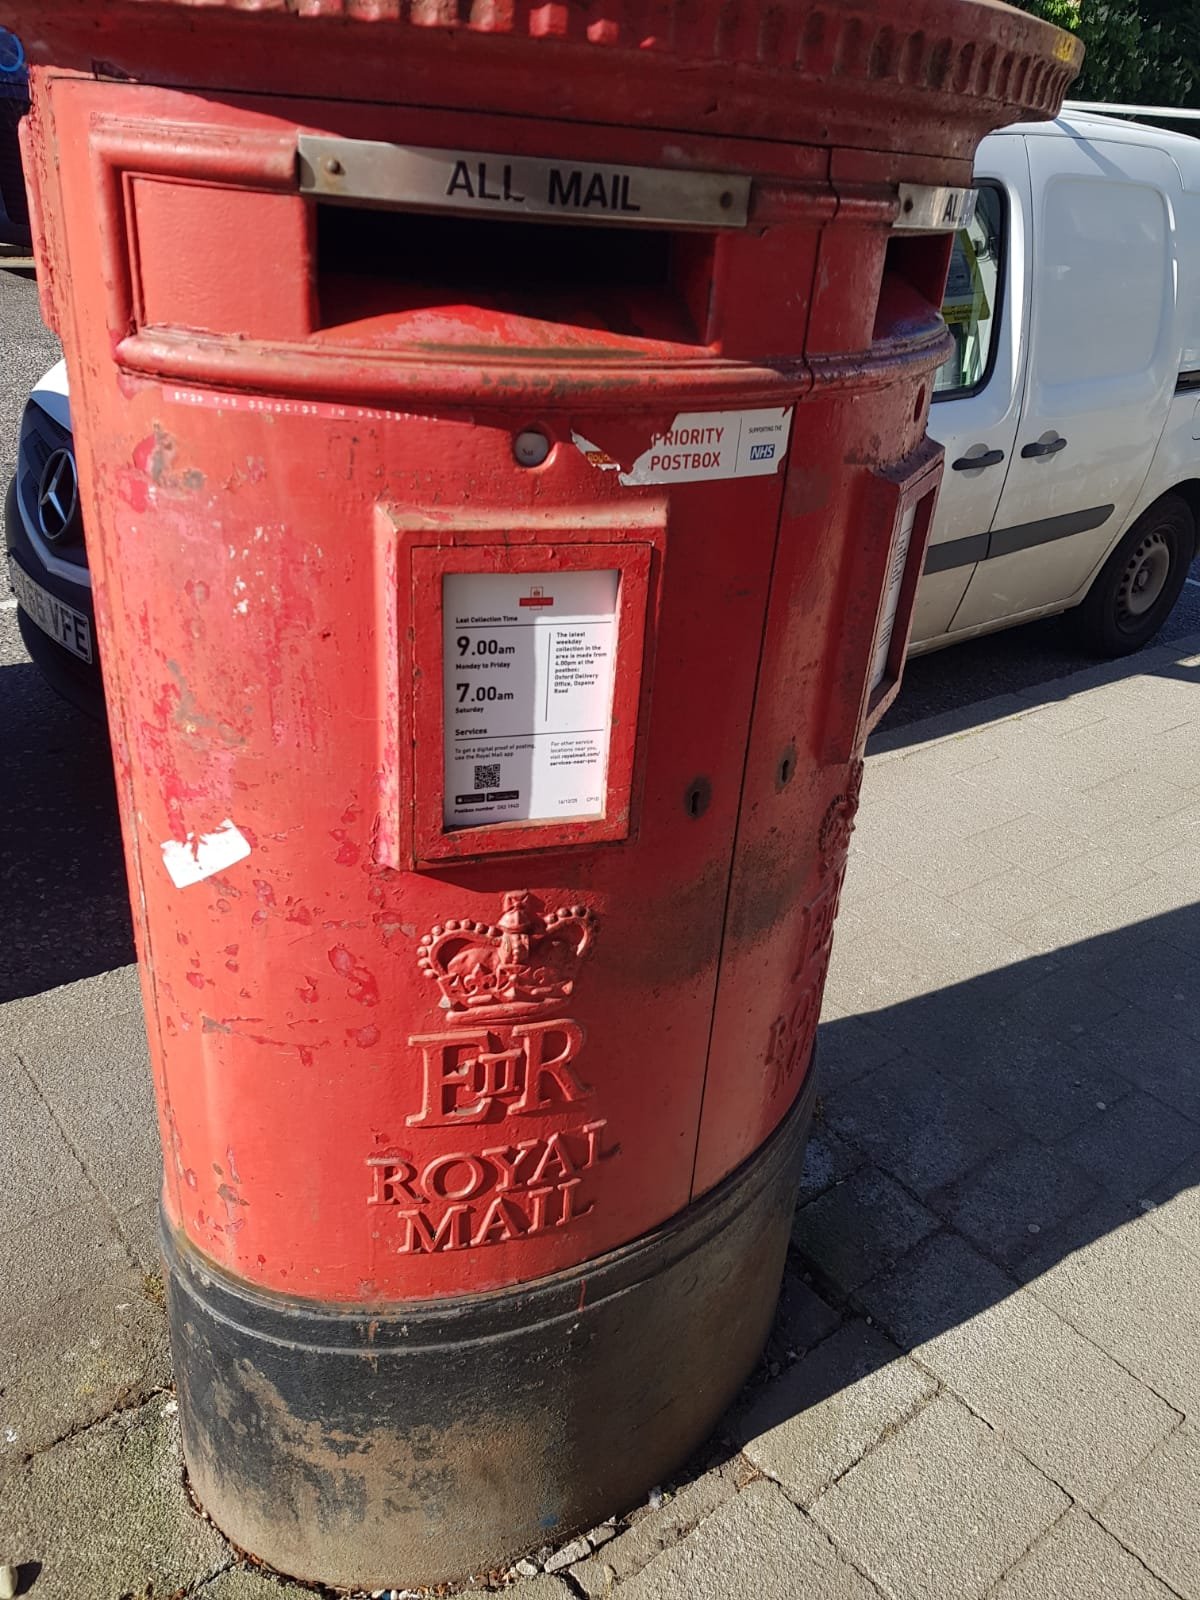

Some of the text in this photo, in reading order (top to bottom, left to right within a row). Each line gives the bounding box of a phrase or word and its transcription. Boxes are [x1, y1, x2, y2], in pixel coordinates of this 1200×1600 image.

[446, 160, 641, 213] ALL MAIL
[174, 391, 204, 404] STOP
[212, 396, 238, 408] THE
[330, 407, 346, 418] IN
[652, 427, 725, 447] PRIORITY
[748, 424, 782, 434] SUPPORTING THE
[650, 452, 721, 471] POSTBOX
[750, 445, 774, 459] NHS
[49, 599, 89, 656] VFE
[470, 615, 502, 623] Collection
[456, 636, 516, 656] 9.00am
[456, 663, 481, 671] Monday
[490, 661, 511, 670] Friday
[456, 683, 514, 703] 7.00am
[455, 706, 484, 714] Saturday
[455, 728, 487, 736] Services
[477, 745, 493, 753] digital
[366, 1118, 621, 1205] ROYAL
[397, 1178, 595, 1254] MAIL
